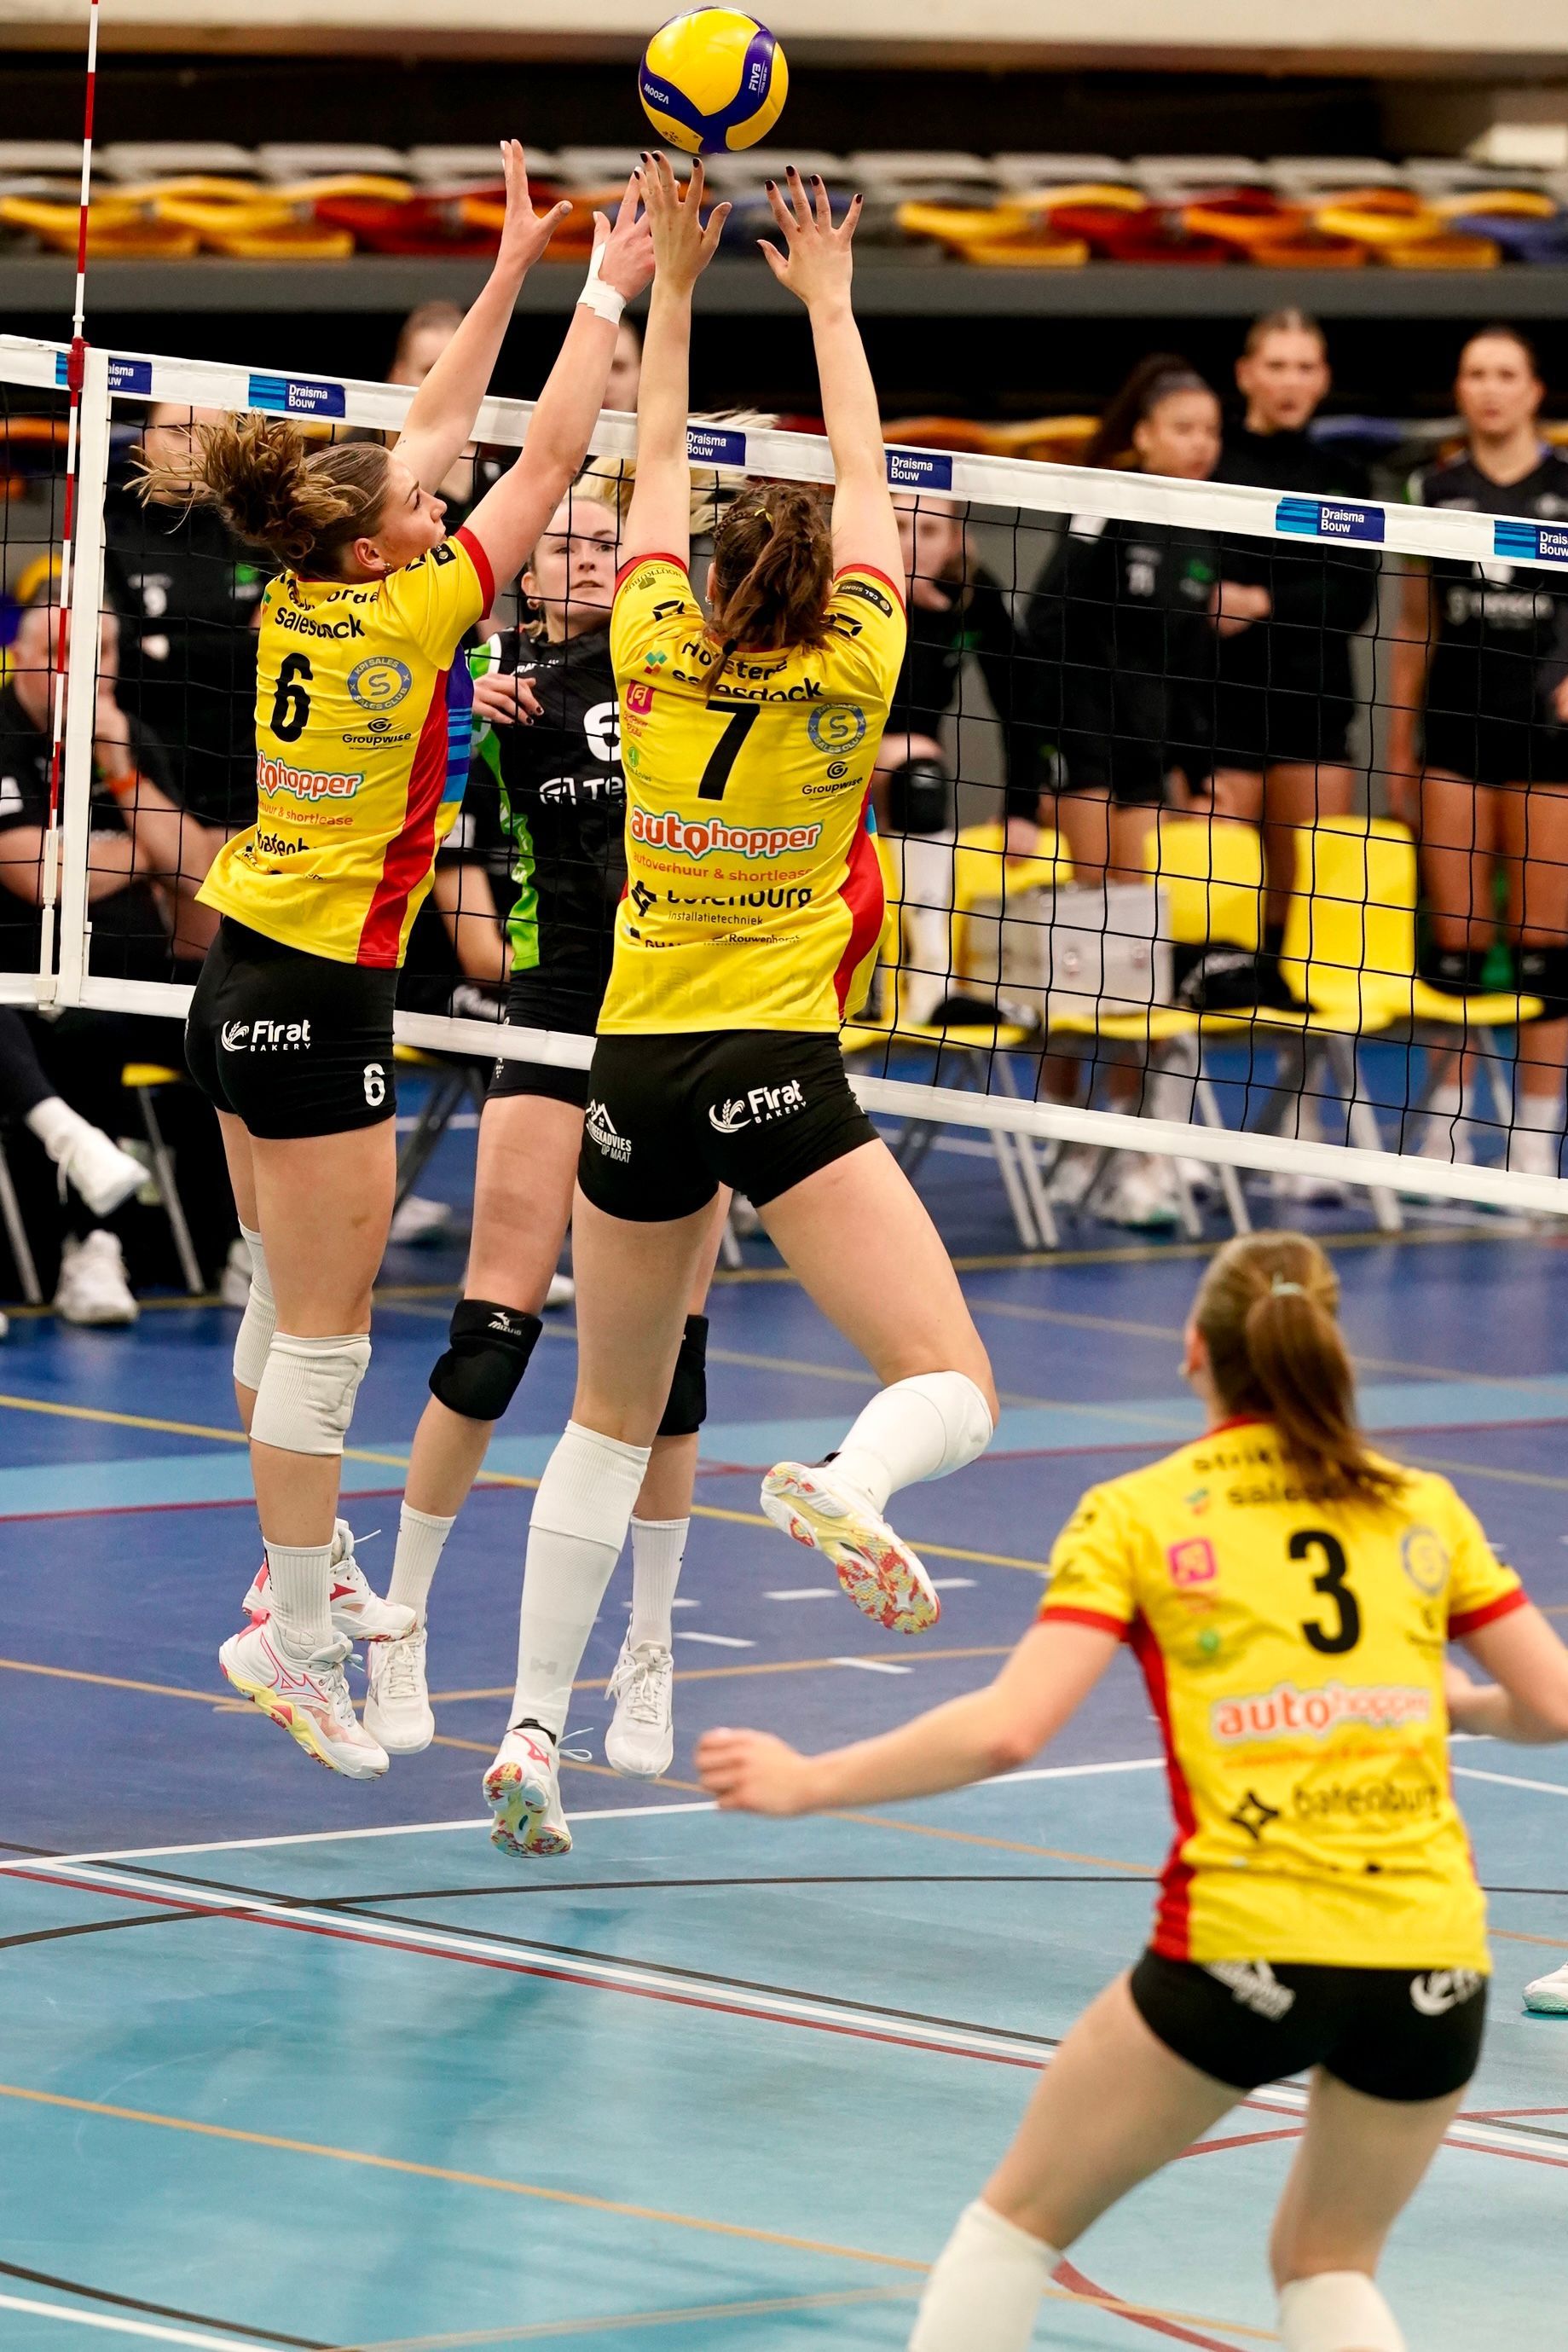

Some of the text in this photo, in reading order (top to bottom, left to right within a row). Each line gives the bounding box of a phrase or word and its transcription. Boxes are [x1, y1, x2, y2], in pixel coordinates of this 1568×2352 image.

[749, 63, 761, 91] FIVB
[644, 83, 669, 104] V200W
[108, 364, 134, 376] isma
[108, 377, 121, 385] uw
[289, 384, 327, 399] Draisma
[288, 396, 315, 409] Bouw
[686, 432, 726, 447] Draisma
[686, 443, 713, 456] Bouw
[892, 456, 933, 471] Draisma
[891, 467, 919, 481] Bouw
[1322, 507, 1364, 523] Draisma
[1321, 519, 1351, 532] Bouw
[1540, 531, 1568, 545] Drais
[1539, 543, 1568, 557] Bouw
[355, 658, 400, 675] KPI SALES
[270, 652, 314, 743] 6
[354, 687, 408, 710] SALES CLUB
[342, 733, 412, 746] Groupwise
[698, 699, 761, 801] 7
[257, 753, 360, 799] tohopper
[583, 776, 623, 800] Te
[802, 777, 863, 795] Groupwise
[286, 810, 354, 826] shortlease
[631, 809, 820, 856] autohopper
[634, 852, 709, 878] autoverhuur
[714, 868, 724, 879] &
[668, 911, 764, 925] installatietechniek
[252, 1019, 311, 1043] Firat
[250, 1043, 311, 1052] BAKERY
[363, 1063, 386, 1106] 6
[748, 1080, 803, 1115] Firat
[755, 1101, 807, 1124] BAKERY
[610, 1148, 631, 1164] MAAT
[1287, 1528, 1361, 1654] 3
